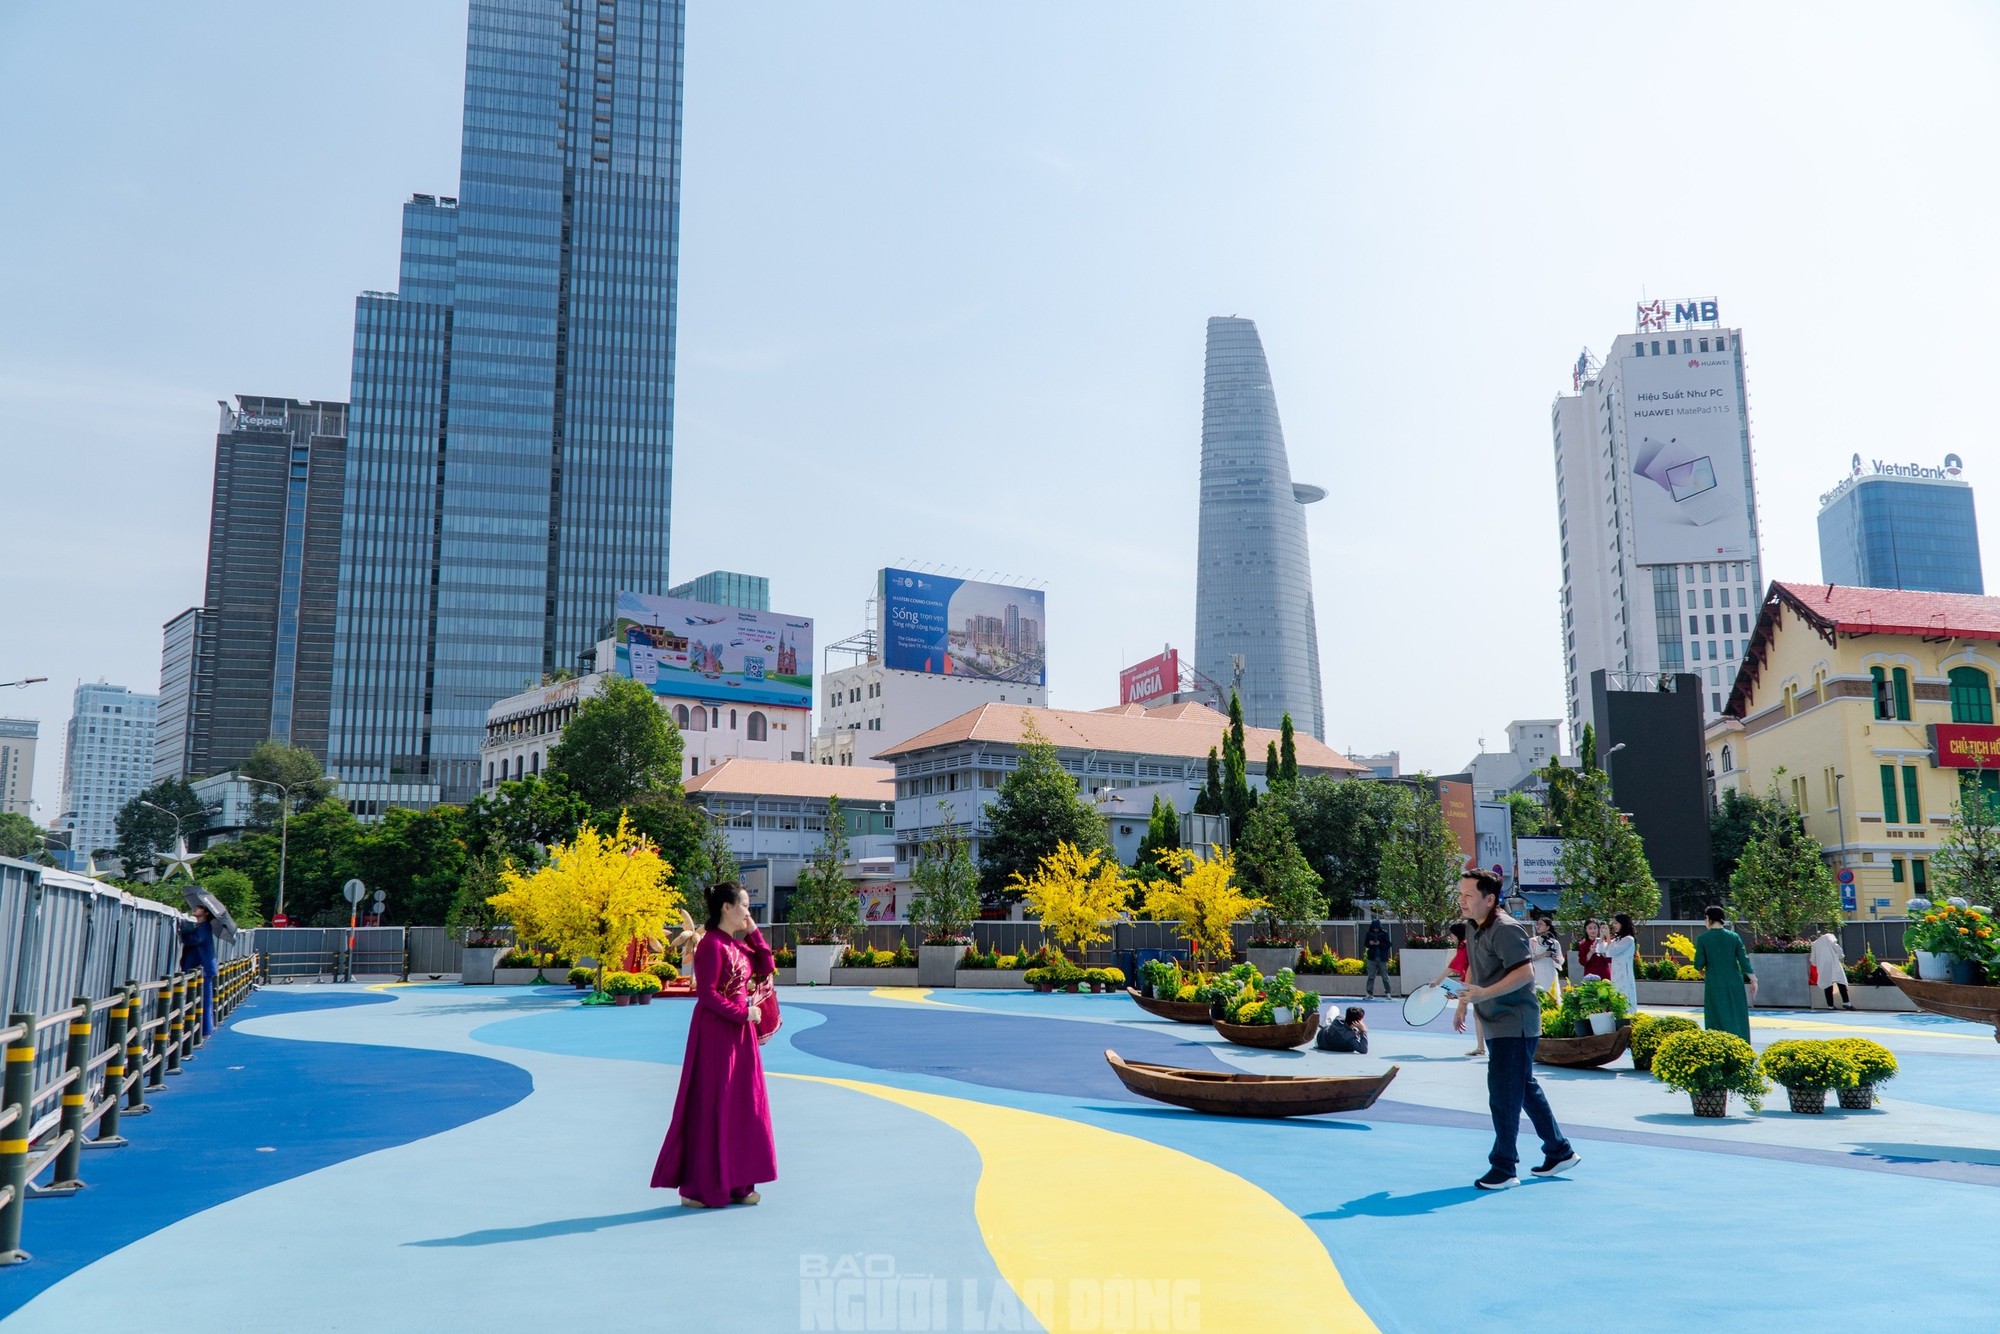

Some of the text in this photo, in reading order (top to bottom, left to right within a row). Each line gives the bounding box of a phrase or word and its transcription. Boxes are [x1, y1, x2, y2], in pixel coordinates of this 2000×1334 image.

[1675, 301, 1718, 323] MB
[1637, 388, 1723, 402] Hiệu Suất Như PC
[241, 414, 282, 427] Keppel
[1634, 405, 1730, 418] HUAWEI MatePad 11.5
[1872, 459, 1946, 479] VietinBank
[892, 606, 919, 624] Sống
[93, 686, 124, 694] SHERATON
[1128, 674, 1163, 702] ANGIA
[1950, 736, 1968, 754] CHỦ
